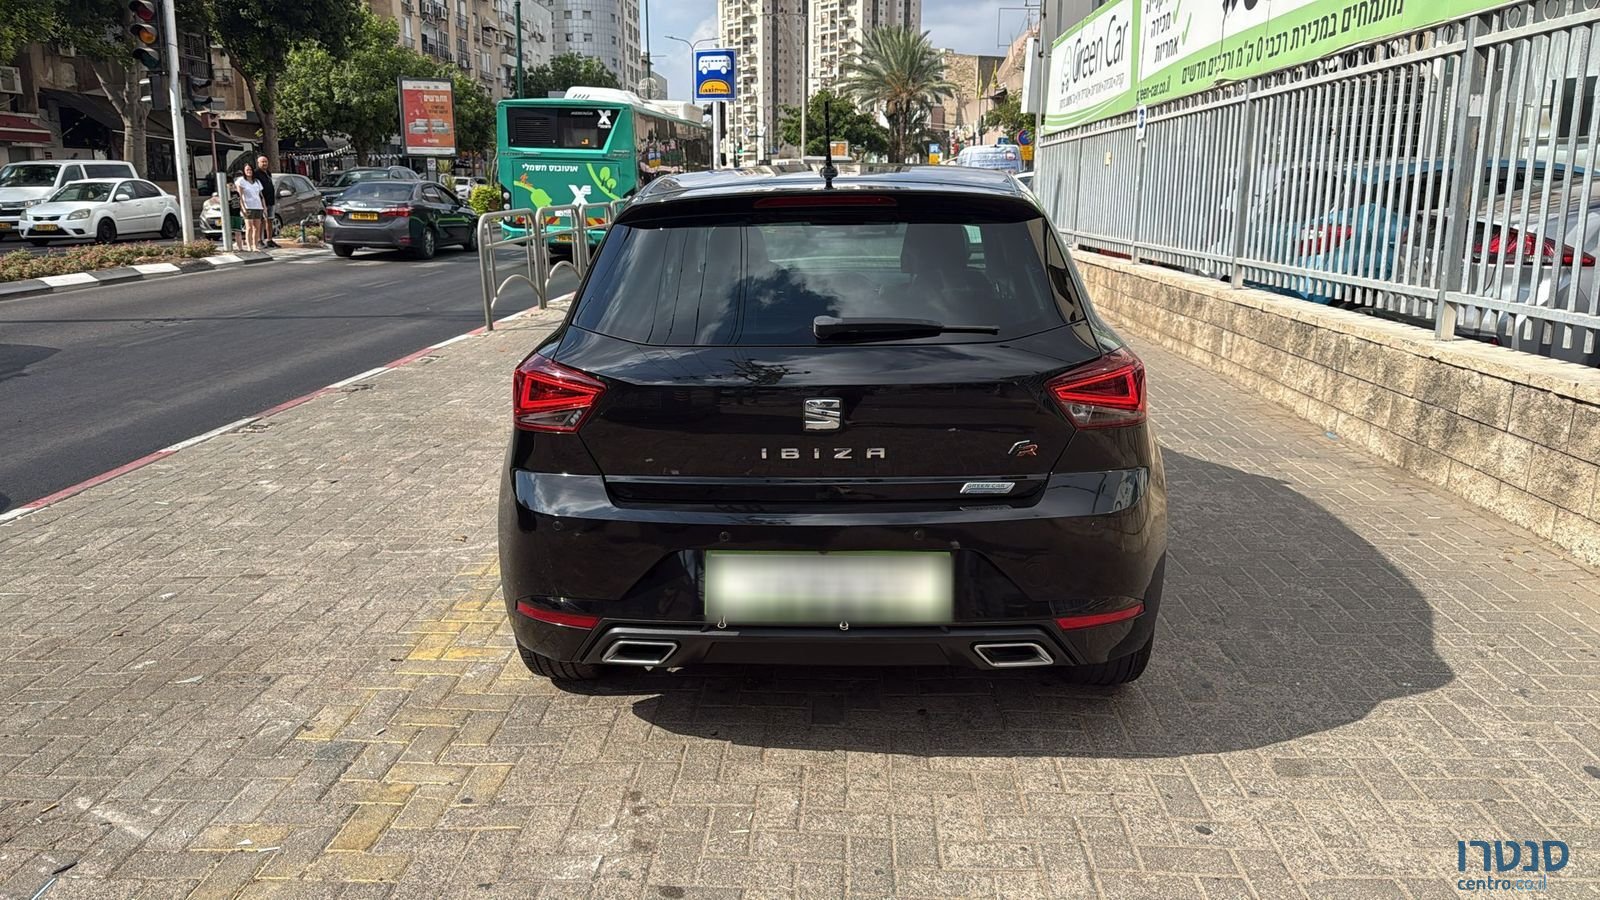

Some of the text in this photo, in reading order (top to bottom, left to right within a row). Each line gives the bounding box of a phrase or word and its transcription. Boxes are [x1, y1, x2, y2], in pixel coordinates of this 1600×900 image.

[1151, 12, 1171, 38] מכירה
[1290, 12, 1337, 51] במכירת
[1072, 14, 1129, 84] Green Car
[1154, 35, 1179, 63] אחריות
[1256, 36, 1264, 62] 0
[1266, 31, 1288, 58] רכבי
[1181, 60, 1207, 85] חדשים
[521, 163, 579, 172] אוטובוס חשמלי
[760, 447, 886, 460] IBIZA
